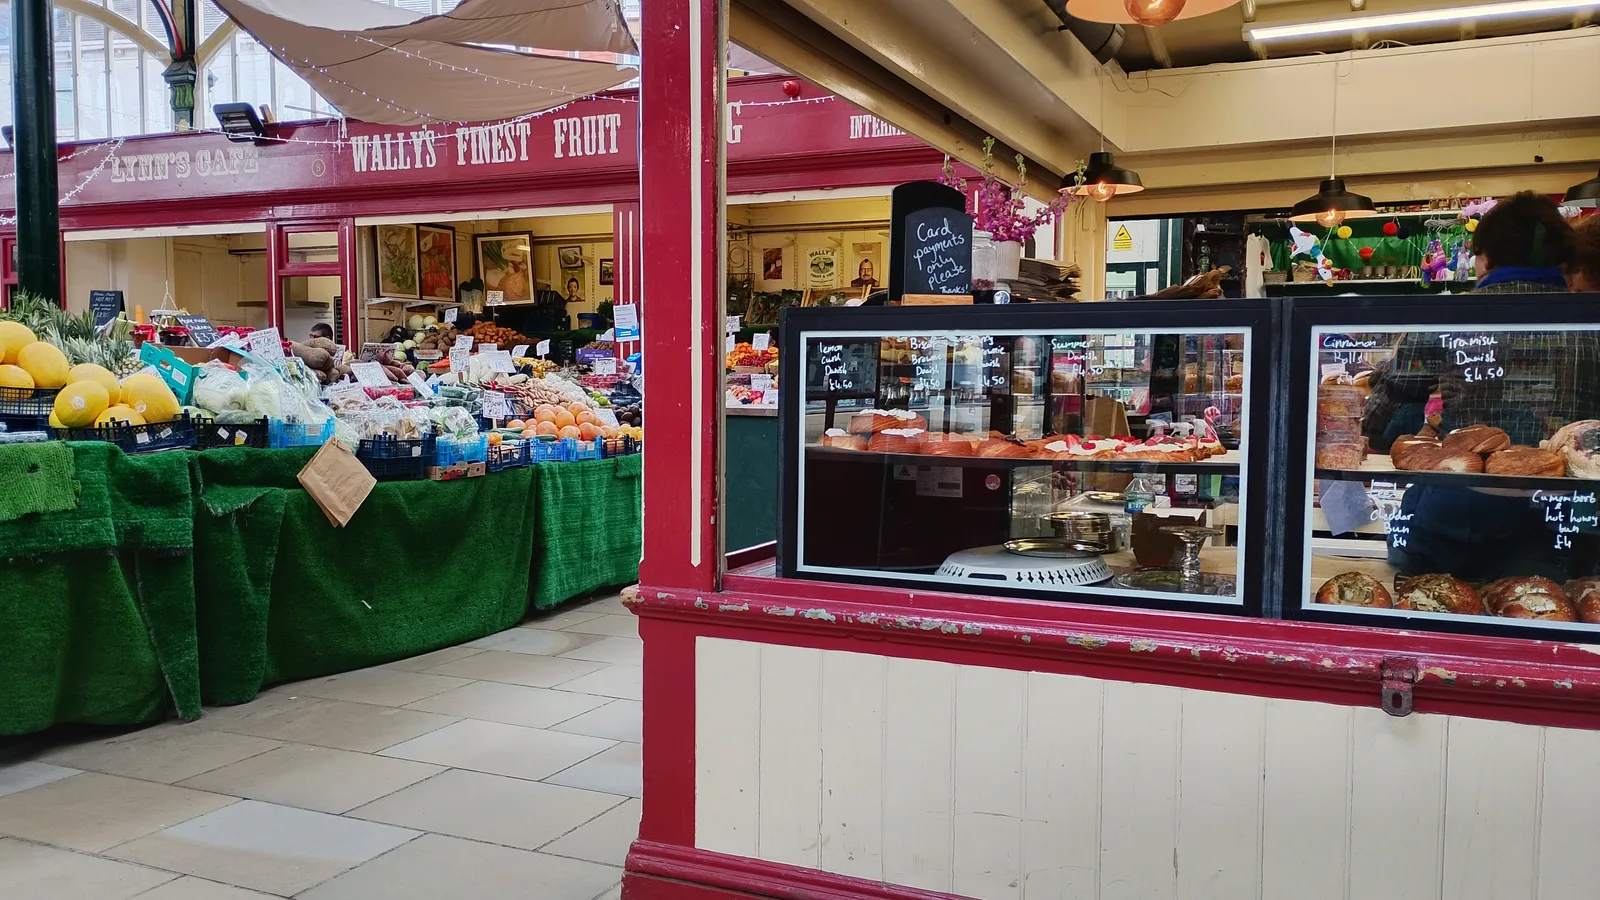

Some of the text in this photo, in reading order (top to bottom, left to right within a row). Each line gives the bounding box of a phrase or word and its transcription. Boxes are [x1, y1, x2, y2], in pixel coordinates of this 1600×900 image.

[350, 113, 621, 172] WALLY'S FINEST FRUIT
[110, 151, 191, 183] LYNN'S
[917, 217, 952, 241] Card
[913, 234, 965, 271] payments
[927, 255, 957, 273] only
[928, 265, 966, 290] please
[939, 284, 968, 293] Thanks!
[1051, 339, 1095, 350] Summer
[1323, 336, 1376, 348] Cinnamon
[1439, 333, 1498, 349] Tiramisu
[911, 353, 942, 365] Brownie
[1067, 350, 1097, 361] Danish
[1456, 350, 1496, 365] Danish
[825, 362, 847, 376] Danish
[916, 365, 940, 376] Danish
[1072, 363, 1104, 377] £4.50
[1464, 367, 1504, 382] £4.50
[1370, 507, 1414, 521] Ceddar
[1545, 506, 1598, 527] hot honey
[1384, 522, 1410, 534] Bun
[1559, 523, 1579, 533] bun
[1393, 534, 1407, 548] £4
[1554, 534, 1572, 549] £4
